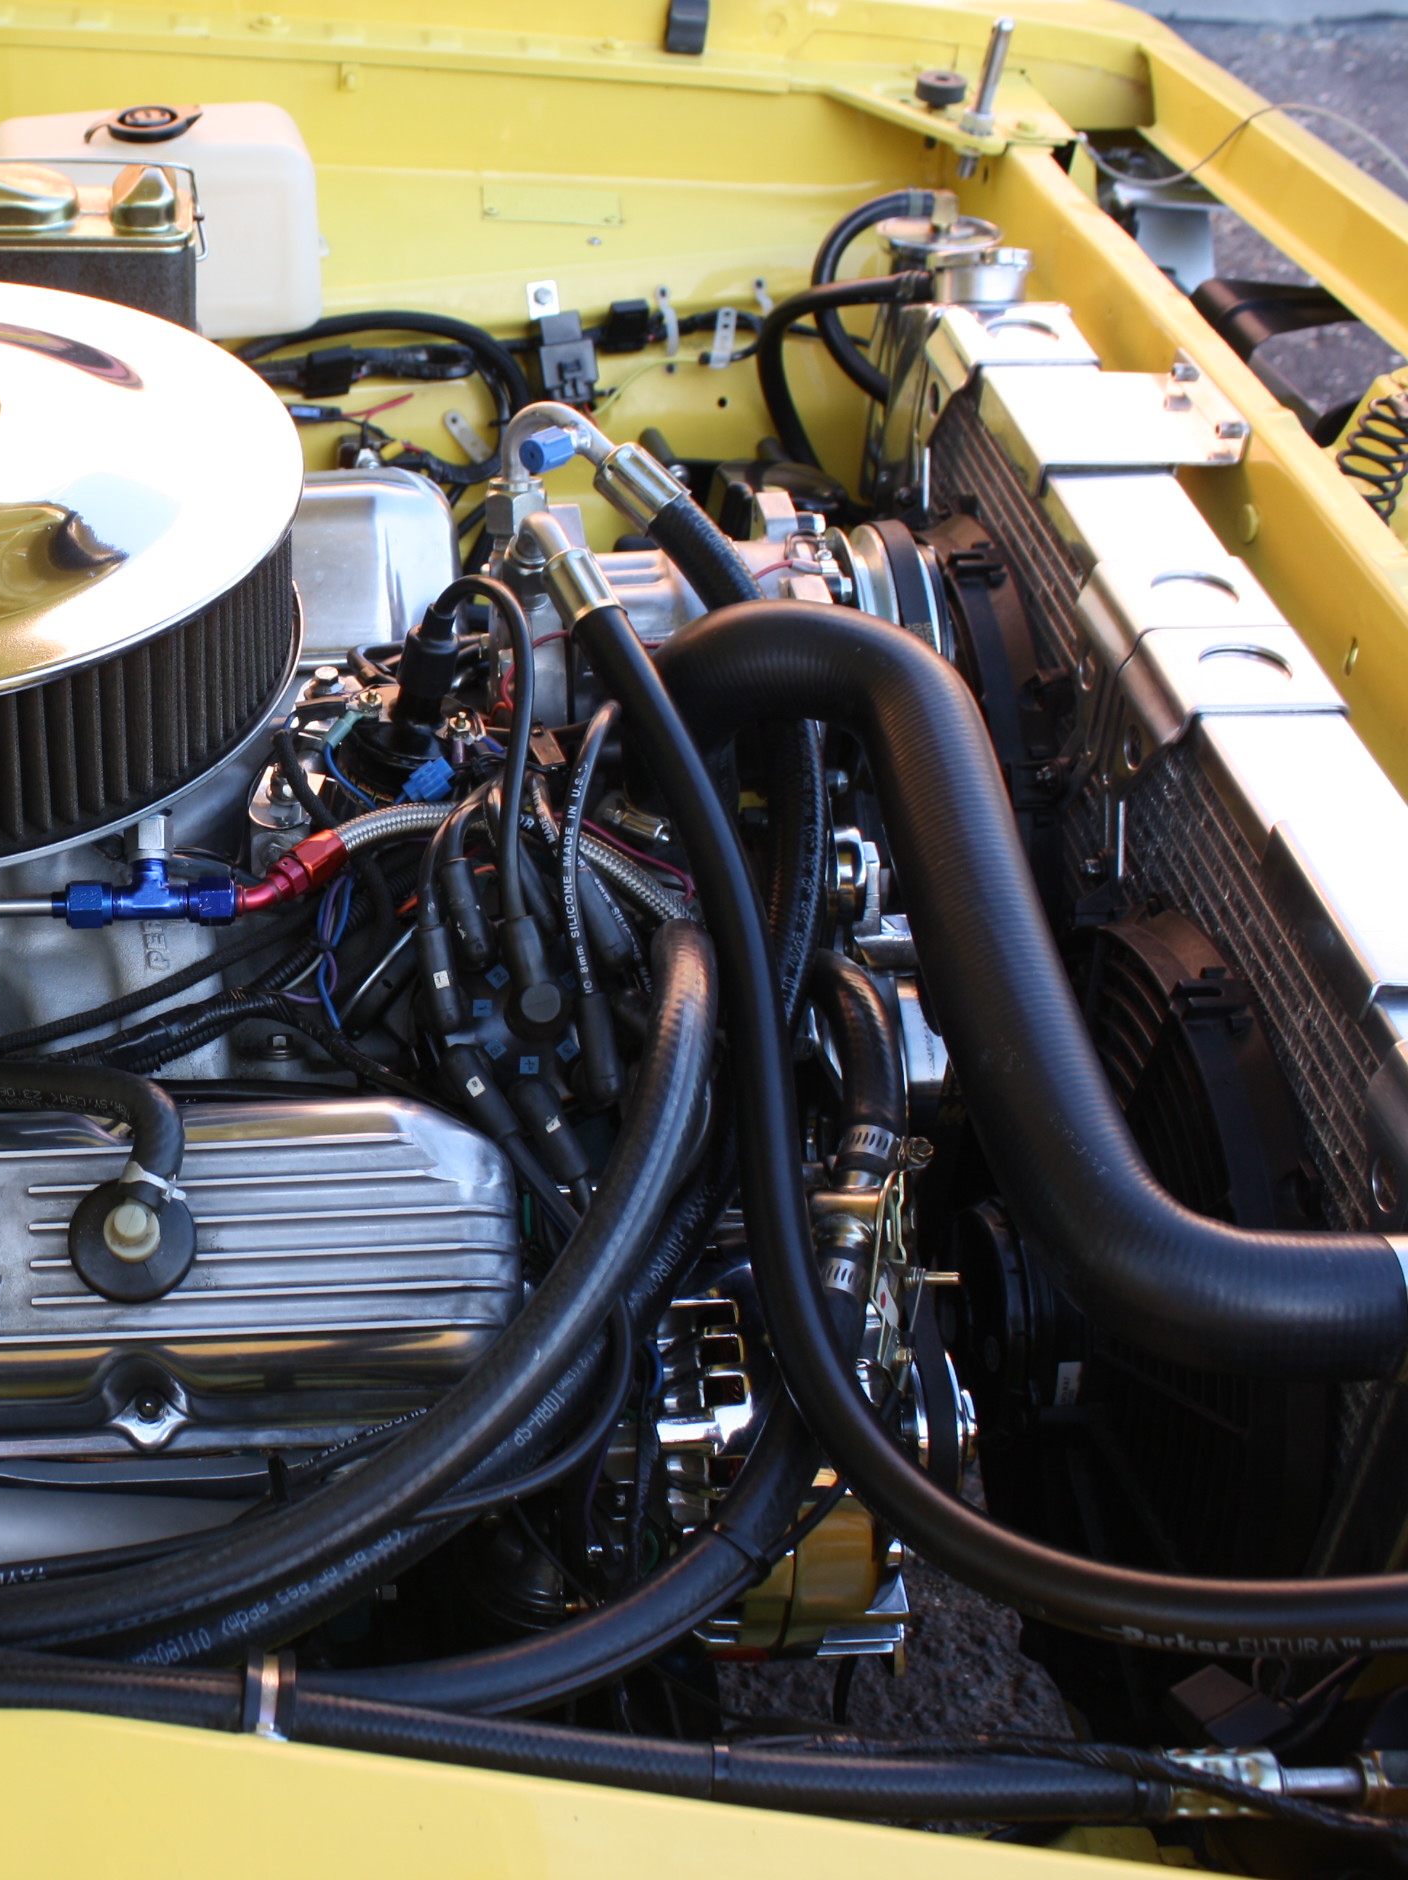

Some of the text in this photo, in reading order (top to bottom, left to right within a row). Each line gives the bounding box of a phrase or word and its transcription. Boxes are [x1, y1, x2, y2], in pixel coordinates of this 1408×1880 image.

[567, 805, 579, 820] IN
[563, 826, 576, 867] MADE
[563, 875, 580, 939] SILICONE
